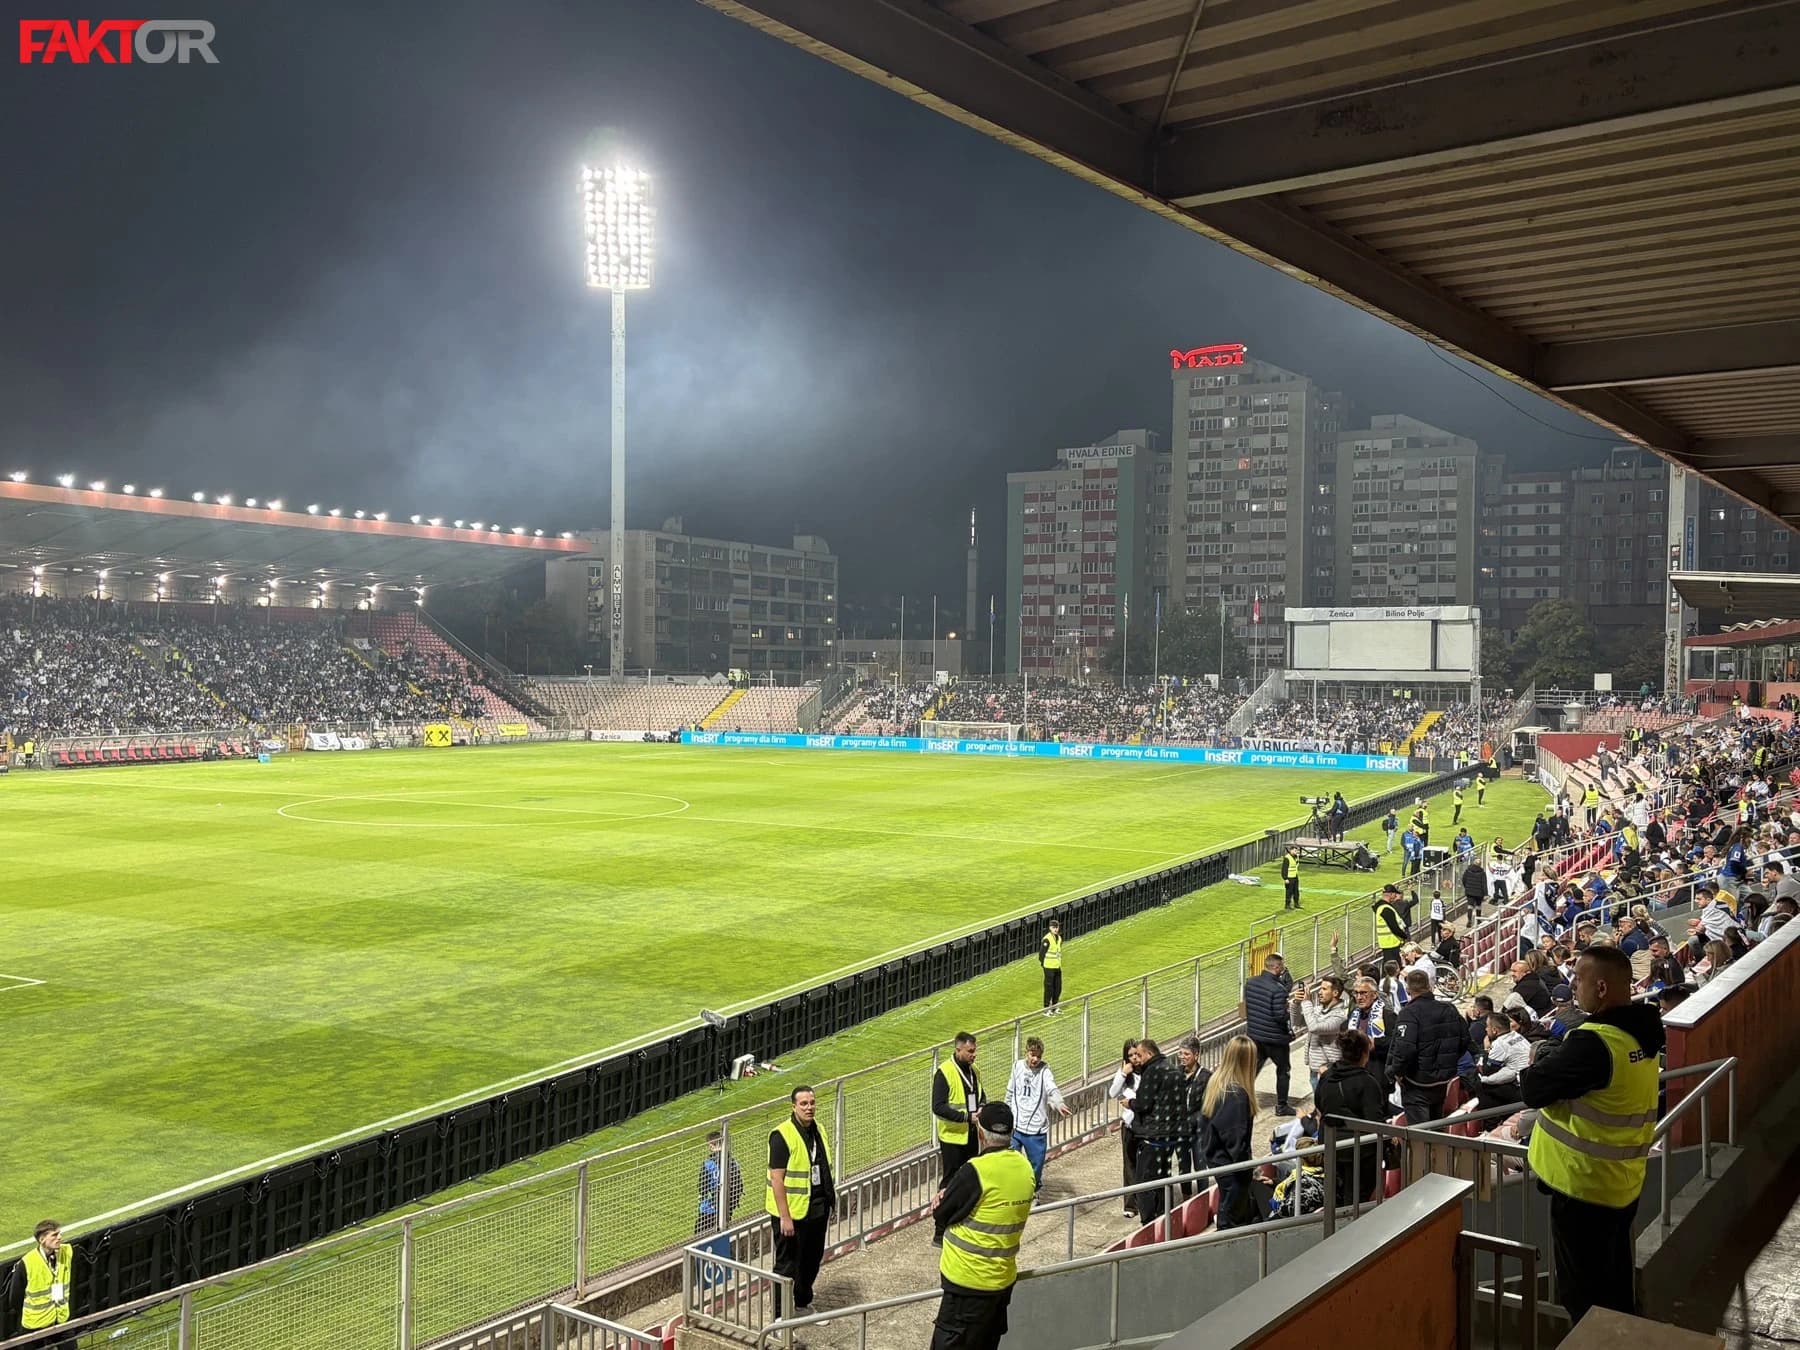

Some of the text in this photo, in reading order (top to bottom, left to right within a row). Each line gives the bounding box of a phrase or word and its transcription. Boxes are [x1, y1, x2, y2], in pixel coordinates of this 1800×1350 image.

[1170, 343, 1244, 369] MADI
[1068, 446, 1133, 458] HVALA EDINE
[613, 566, 621, 592] ALMY
[1329, 610, 1354, 618] Zenica
[1407, 609, 1425, 618] Polje
[691, 734, 786, 745] InsERT programy dla firm
[806, 736, 906, 748] InsERT programy dla firm
[928, 740, 1035, 752] InsERT programy dla firm
[1059, 744, 1179, 759] InsERT programy dla firm
[1204, 750, 1337, 766] InsERT programy dla firm
[1366, 756, 1408, 769] InsERT
[1023, 1085, 1031, 1097] 11
